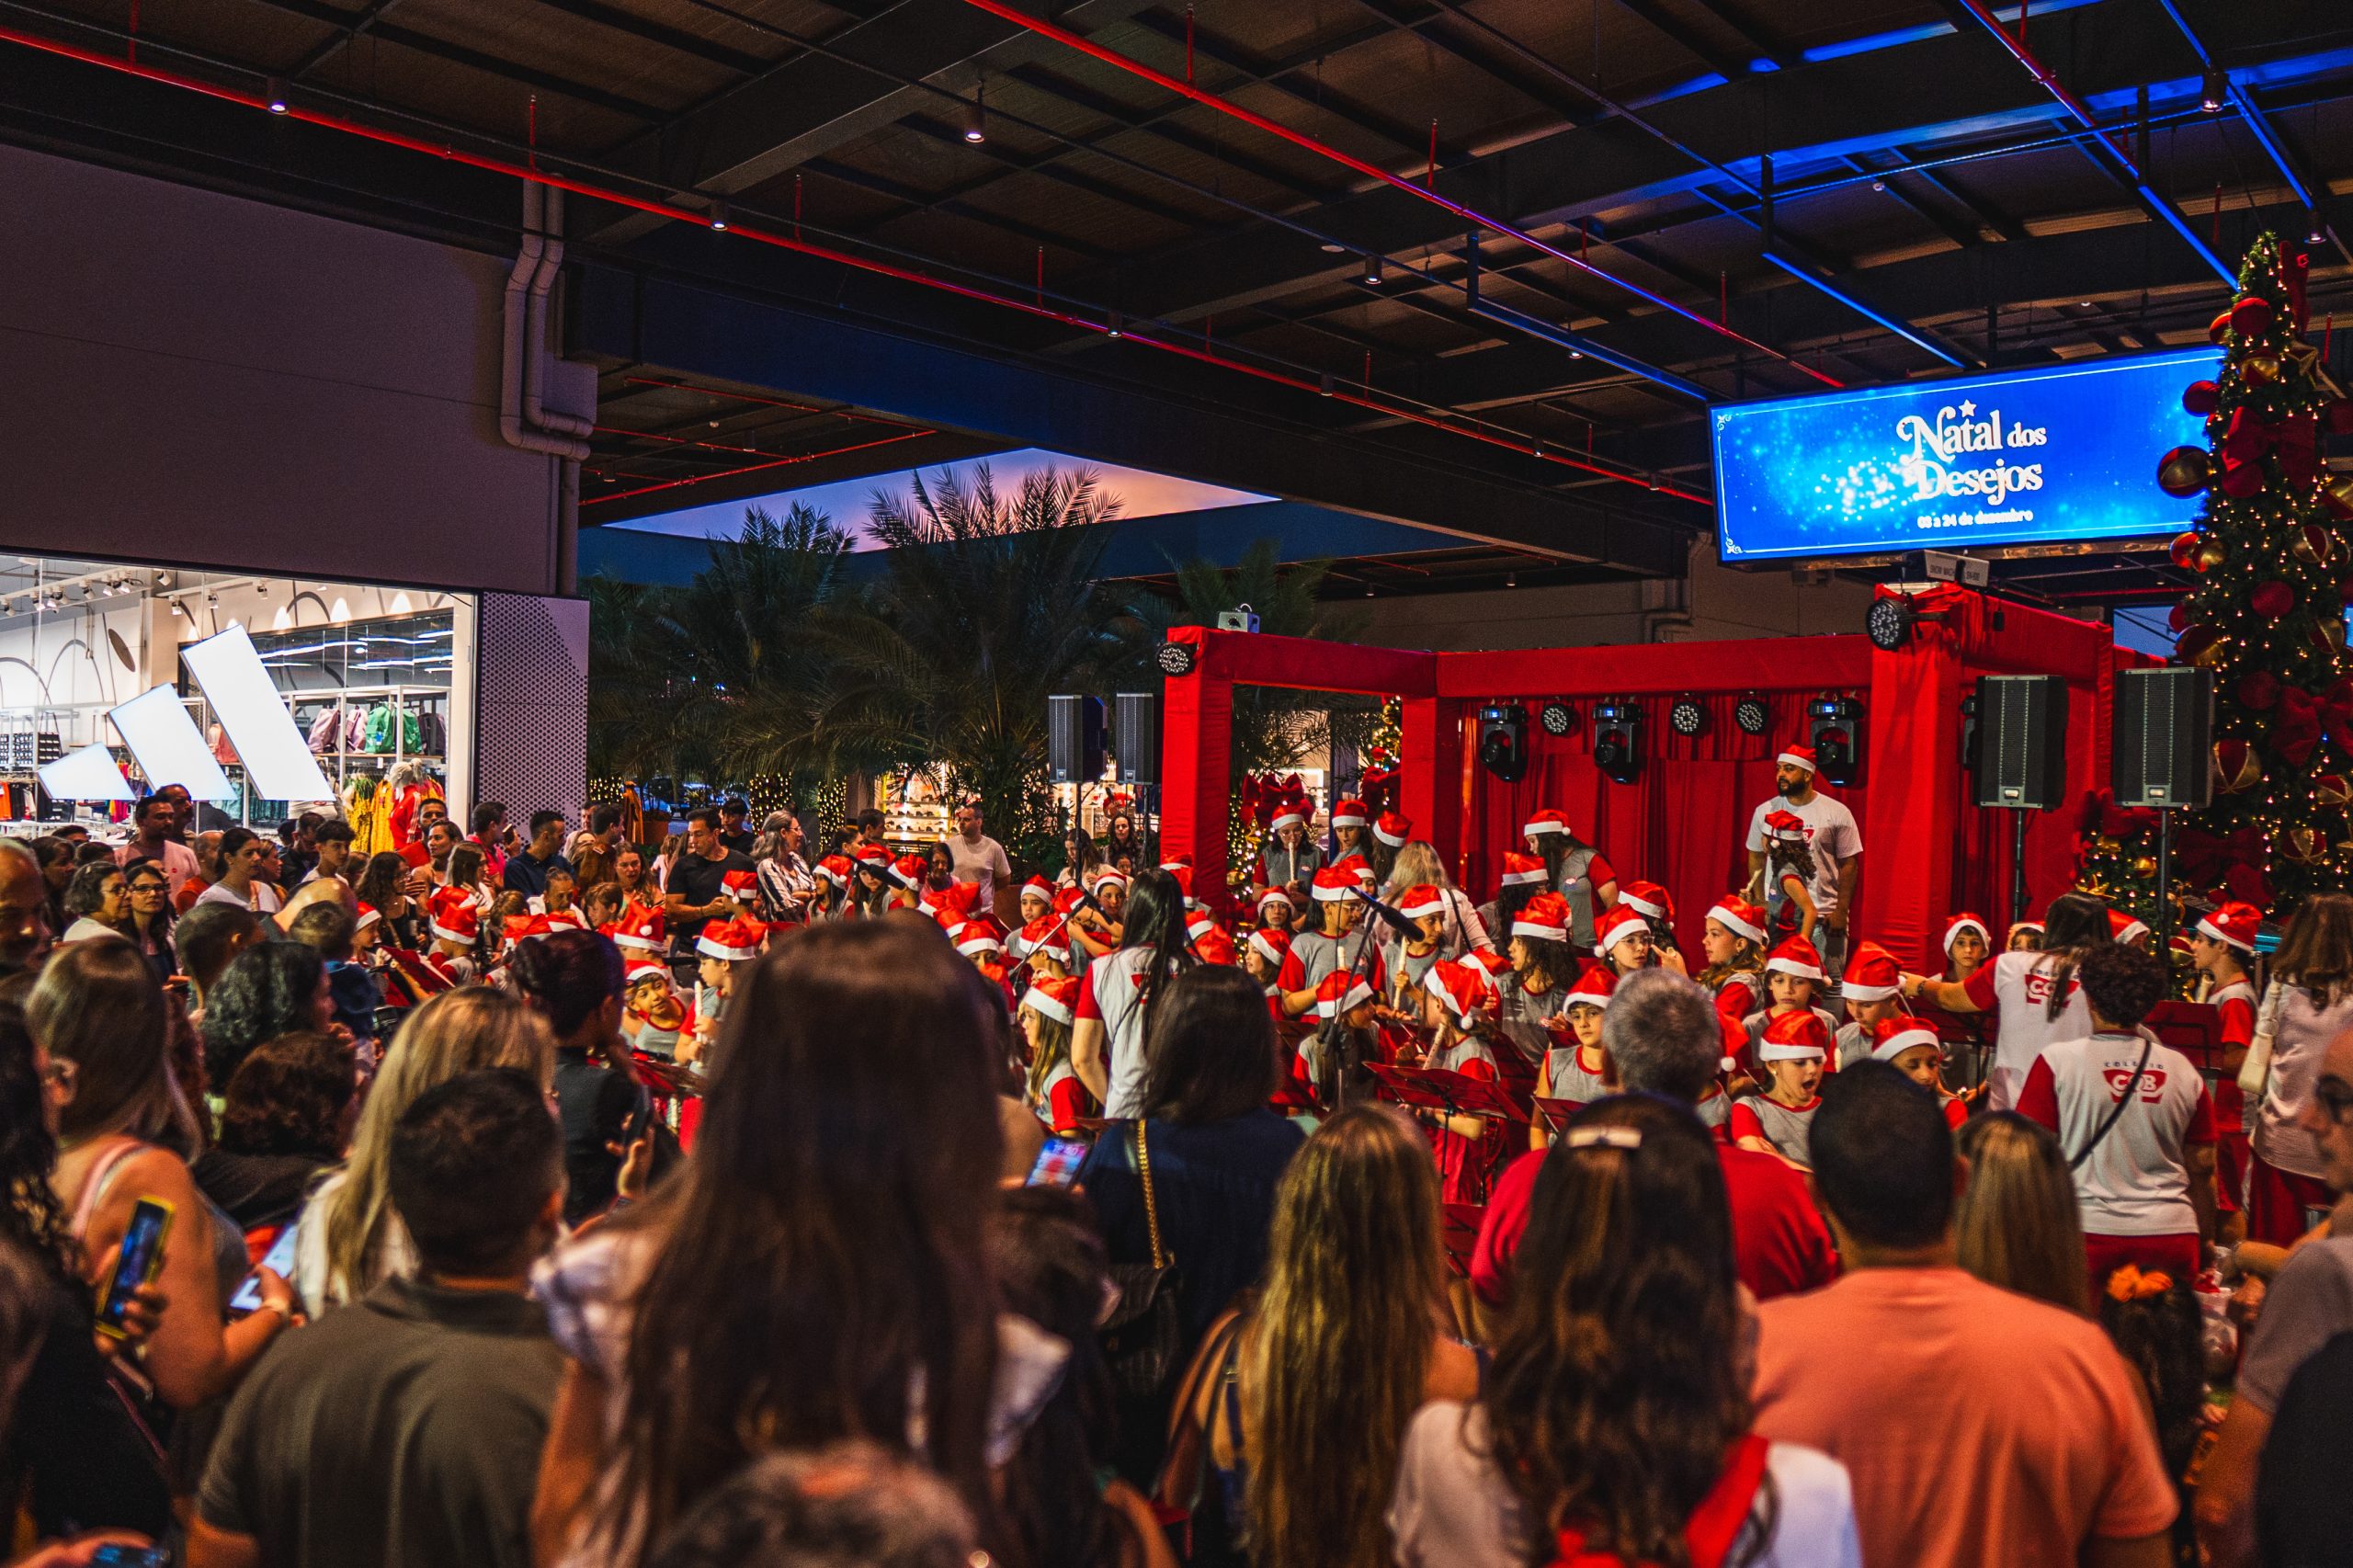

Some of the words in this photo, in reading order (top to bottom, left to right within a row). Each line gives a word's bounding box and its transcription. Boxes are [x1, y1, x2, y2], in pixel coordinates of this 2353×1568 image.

[1896, 406, 2003, 463] Natal
[2006, 422, 2048, 449] dos
[1911, 459, 2043, 506] Desejos
[1933, 517, 1941, 528] a
[1941, 514, 1958, 527] 24
[1958, 511, 1973, 526] de
